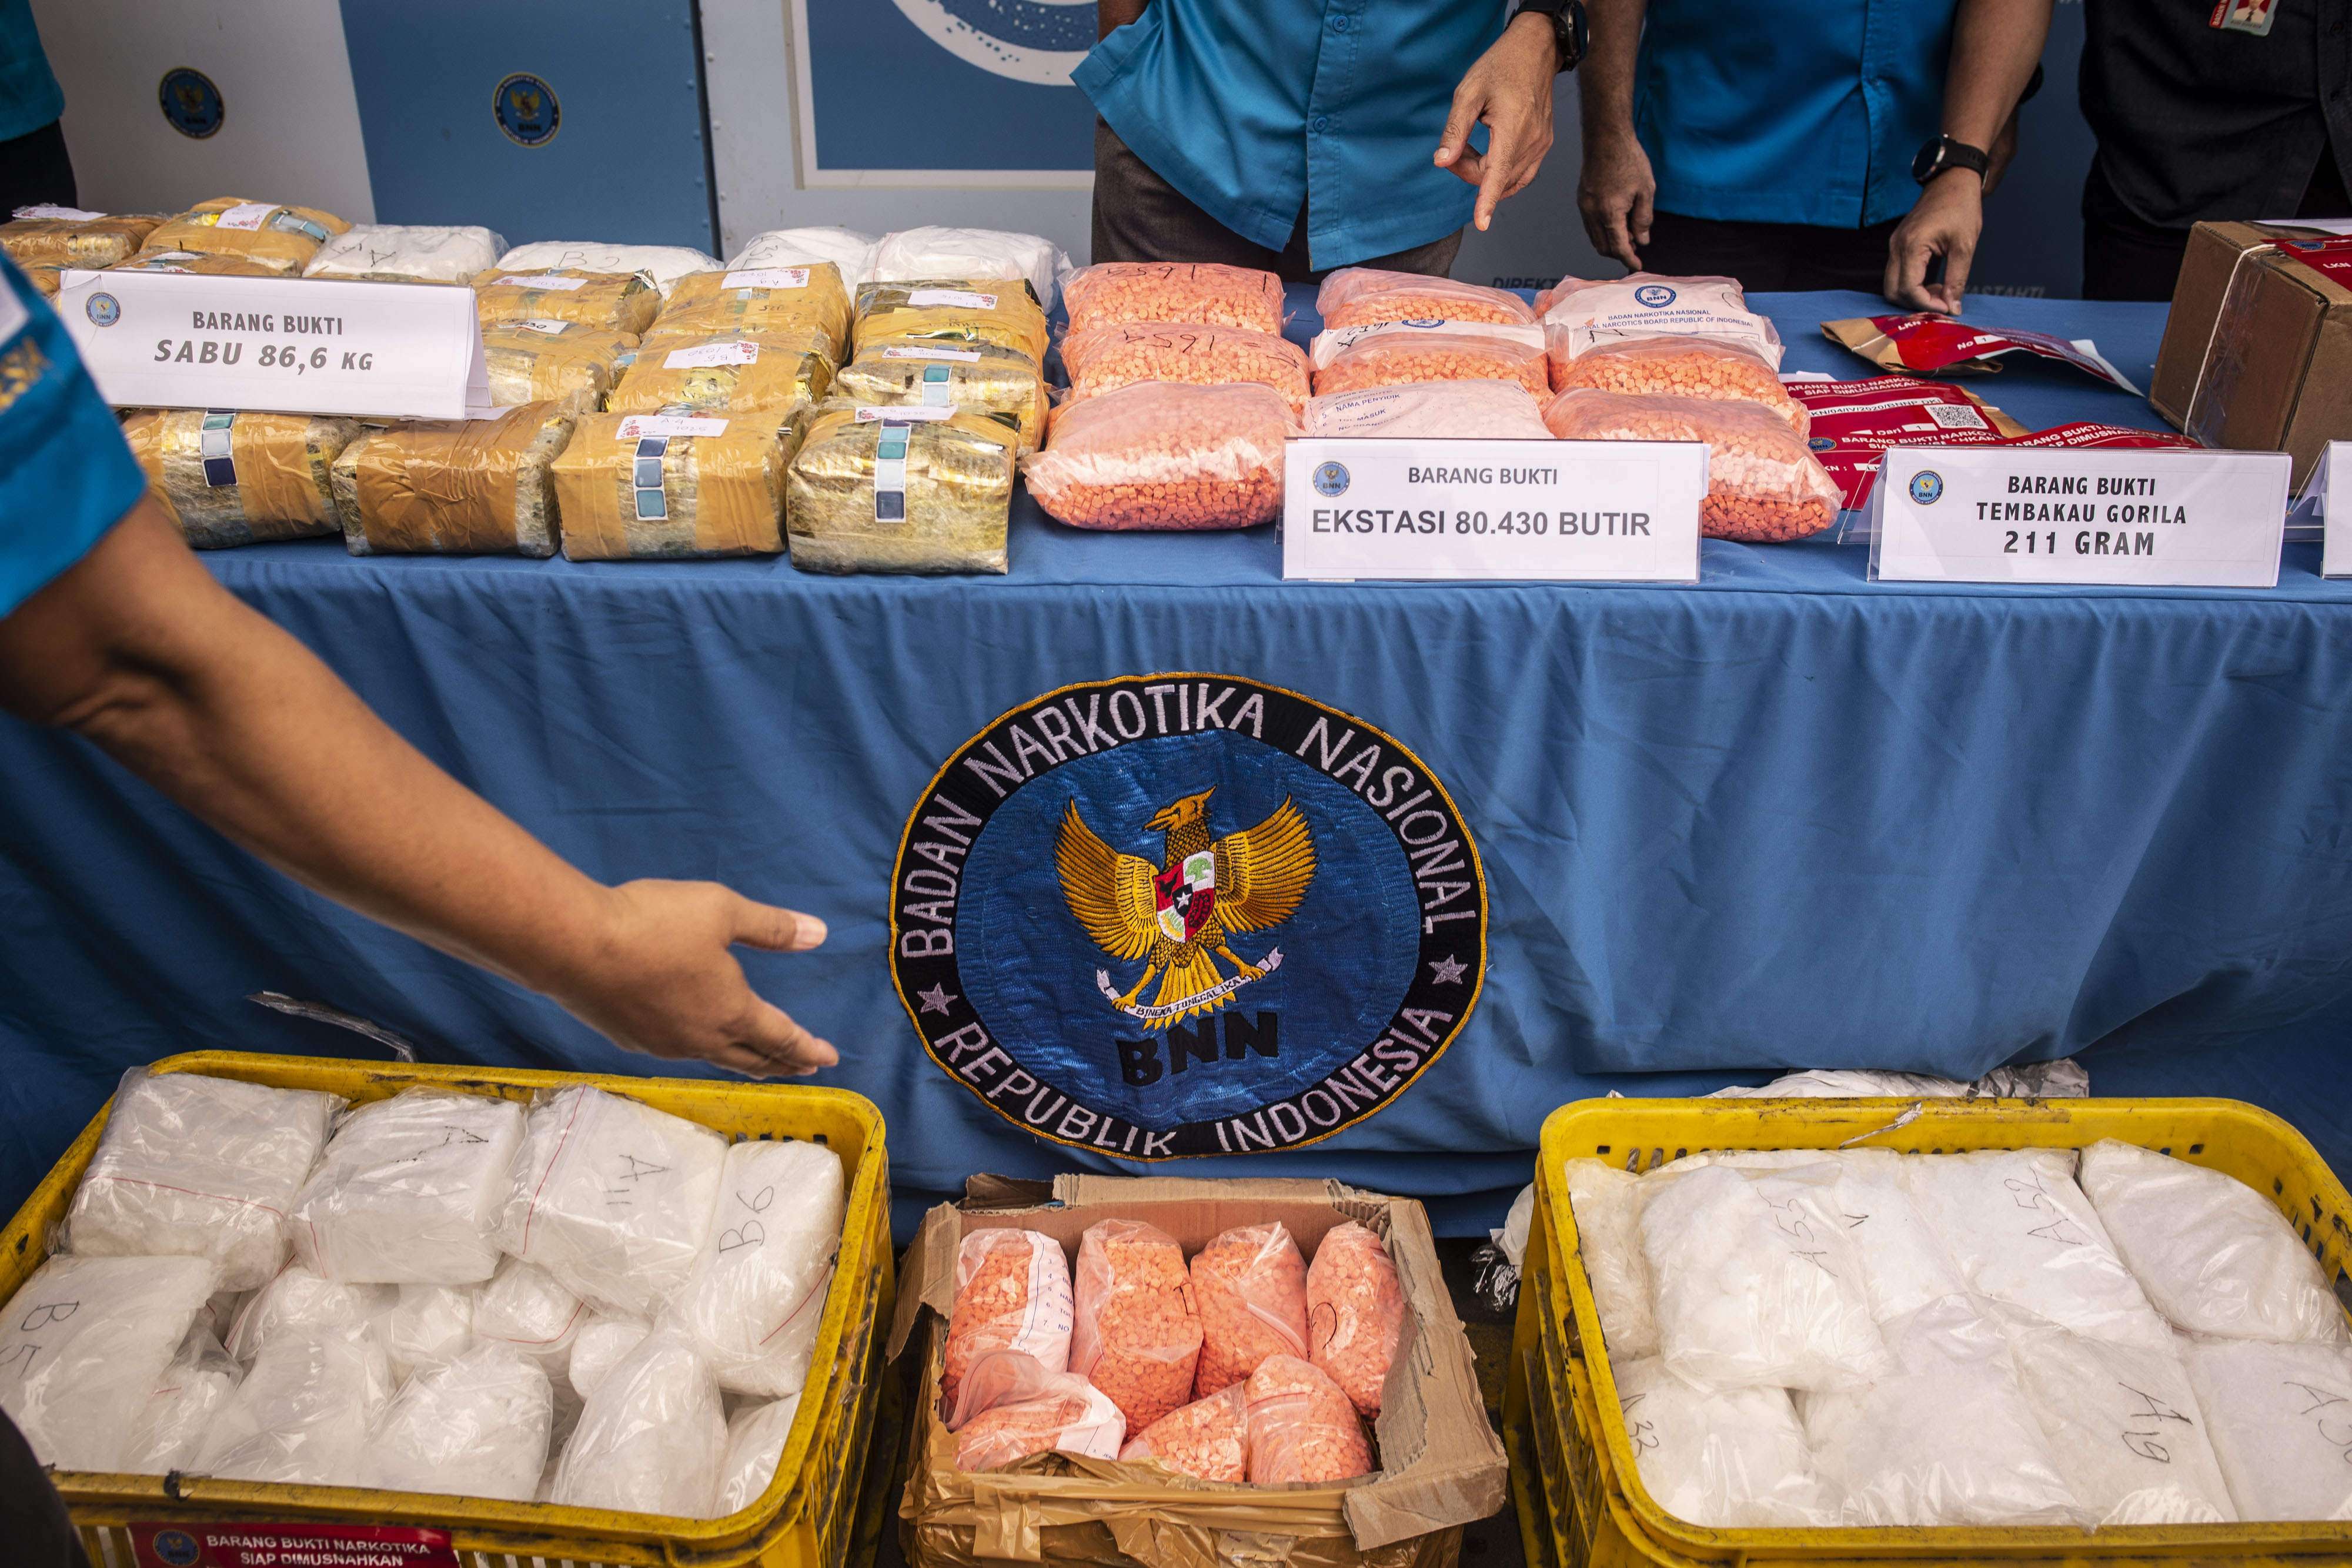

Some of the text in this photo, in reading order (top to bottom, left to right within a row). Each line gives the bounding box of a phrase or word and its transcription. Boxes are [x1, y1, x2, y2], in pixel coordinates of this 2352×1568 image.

[1492, 277, 1561, 290] DIREKT
[193, 311, 342, 335] BARANG BUKTI
[1602, 320, 1642, 329] NARCOTICS
[1634, 310, 1675, 319] NARKOTIKA
[1956, 340, 1974, 350] No
[153, 339, 373, 376] SABU 86,6 KG
[1788, 384, 1829, 392] ARANG
[1833, 381, 1920, 394] DIMUSNAHKAN
[1336, 400, 1361, 413] NAMA
[1361, 393, 1401, 406] PENYIDIK
[1811, 400, 1919, 417] KN/04/IV/2020/BNNP
[1357, 408, 1387, 422] MASUK
[1841, 436, 1896, 444] BARANG
[1898, 435, 1937, 444] BUKTI
[2006, 433, 2060, 446] ARANG
[2062, 424, 2102, 438] BUKTI
[1408, 467, 1557, 484] BARANG BUKTI
[2007, 476, 2156, 496] BARANG BUKTI
[1313, 510, 1651, 536] EKSTASI 80.430 BUTIR
[1976, 502, 2186, 524] TEMBAKAU GORILA
[2003, 530, 2154, 556] 211 GRAM
[901, 683, 1476, 957] BADAN NARKOTIKA NASIONAL
[1175, 989, 1220, 1012] TUNGGAL
[1220, 978, 1242, 994] IKA
[1117, 1011, 1280, 1087] BNN
[934, 1006, 1452, 1156] REPUBLIK INDONESIA
[1058, 1323, 1070, 1332] NO
[206, 1534, 431, 1554] BARANG BUKTI NARKOTIKA
[240, 1552, 403, 1567] SIAP DIMUSNAHKAN
